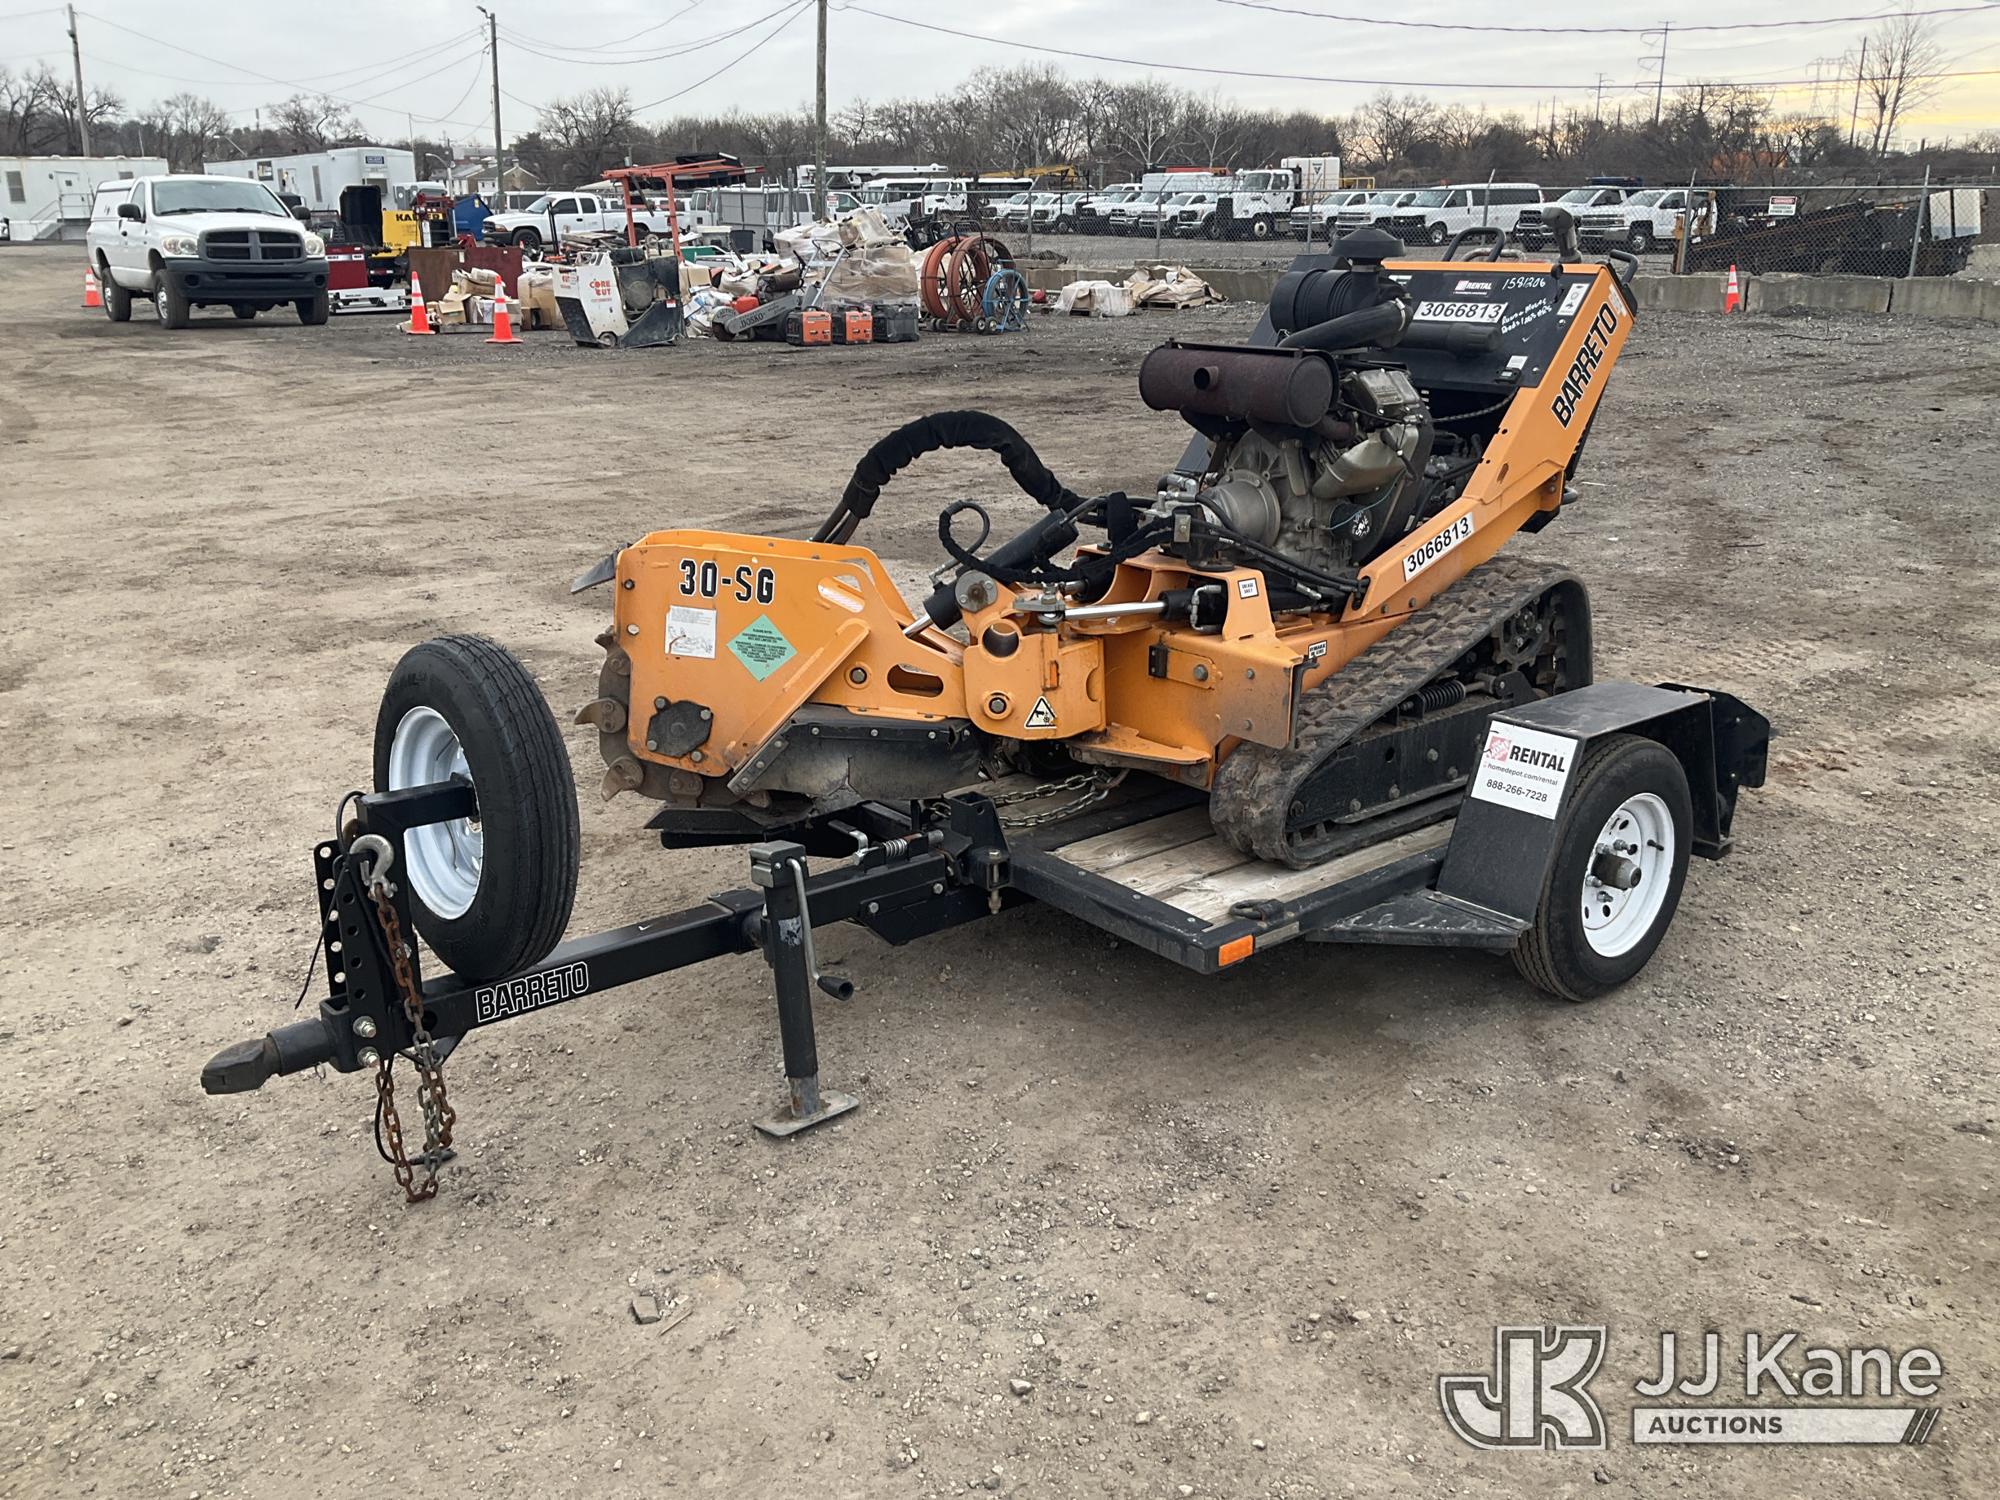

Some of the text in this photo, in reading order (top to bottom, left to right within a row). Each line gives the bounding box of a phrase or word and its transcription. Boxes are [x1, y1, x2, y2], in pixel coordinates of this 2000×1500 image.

[1466, 282, 1492, 290] RENTAL
[1421, 302, 1502, 319] 3066813
[1551, 302, 1617, 428] BARRETO
[1407, 517, 1469, 573] 3066813
[680, 559, 775, 604] 30-SG
[1509, 744, 1565, 773] RENTAL
[1488, 763, 1558, 786] homedepot.com/rental
[1486, 779, 1548, 802] 888-266-7228
[475, 961, 589, 1022] BARRETO
